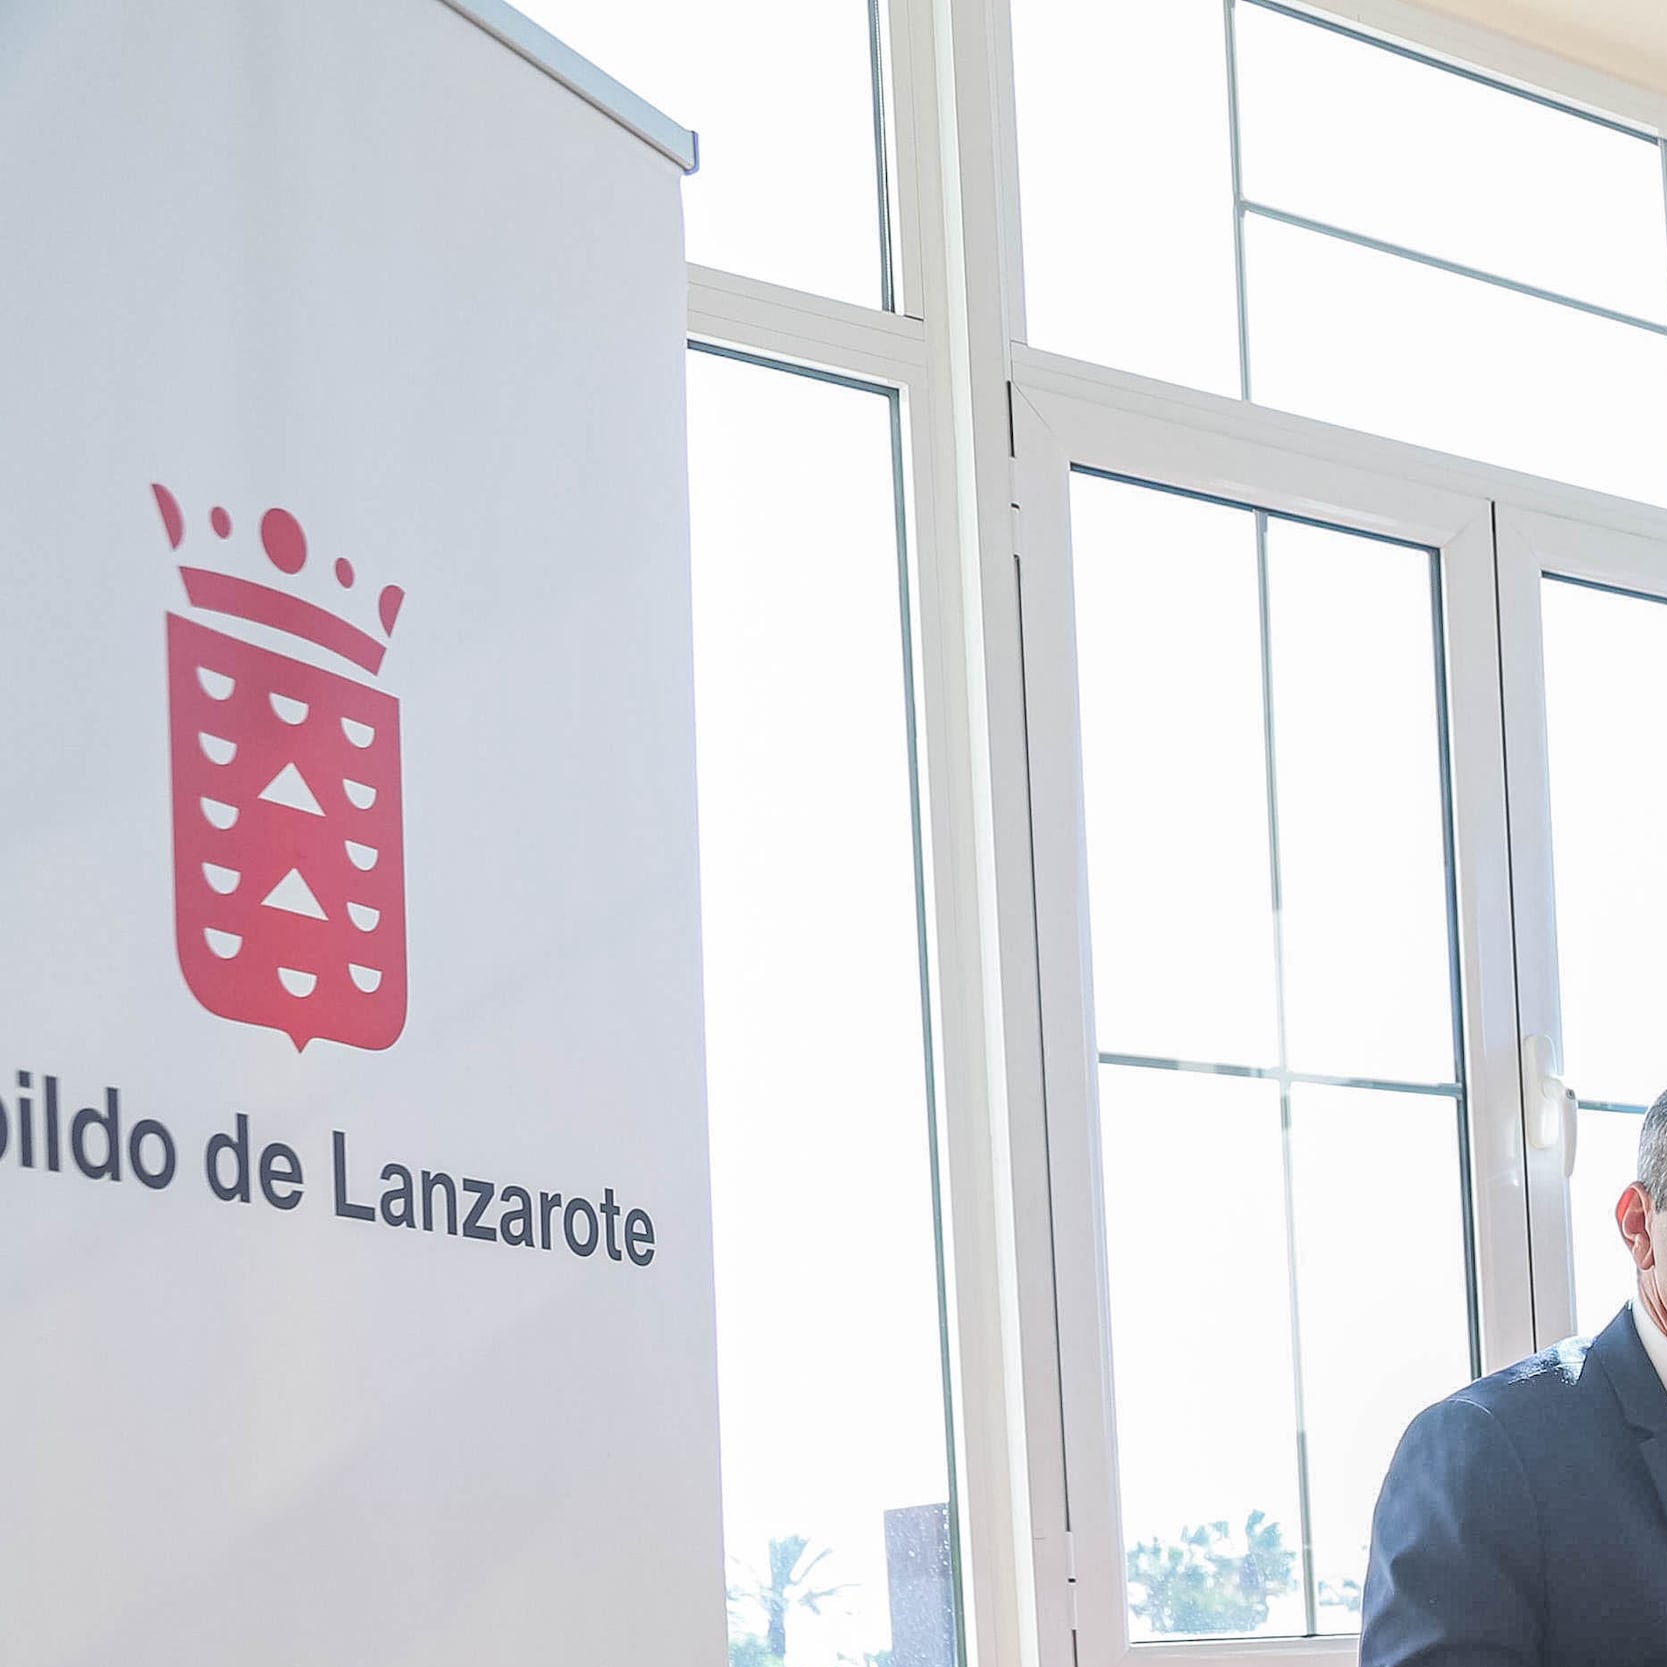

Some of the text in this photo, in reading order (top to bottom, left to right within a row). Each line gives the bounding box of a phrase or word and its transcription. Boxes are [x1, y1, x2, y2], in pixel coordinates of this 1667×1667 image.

[0, 1069, 656, 1267] ildo de Lanzarote
